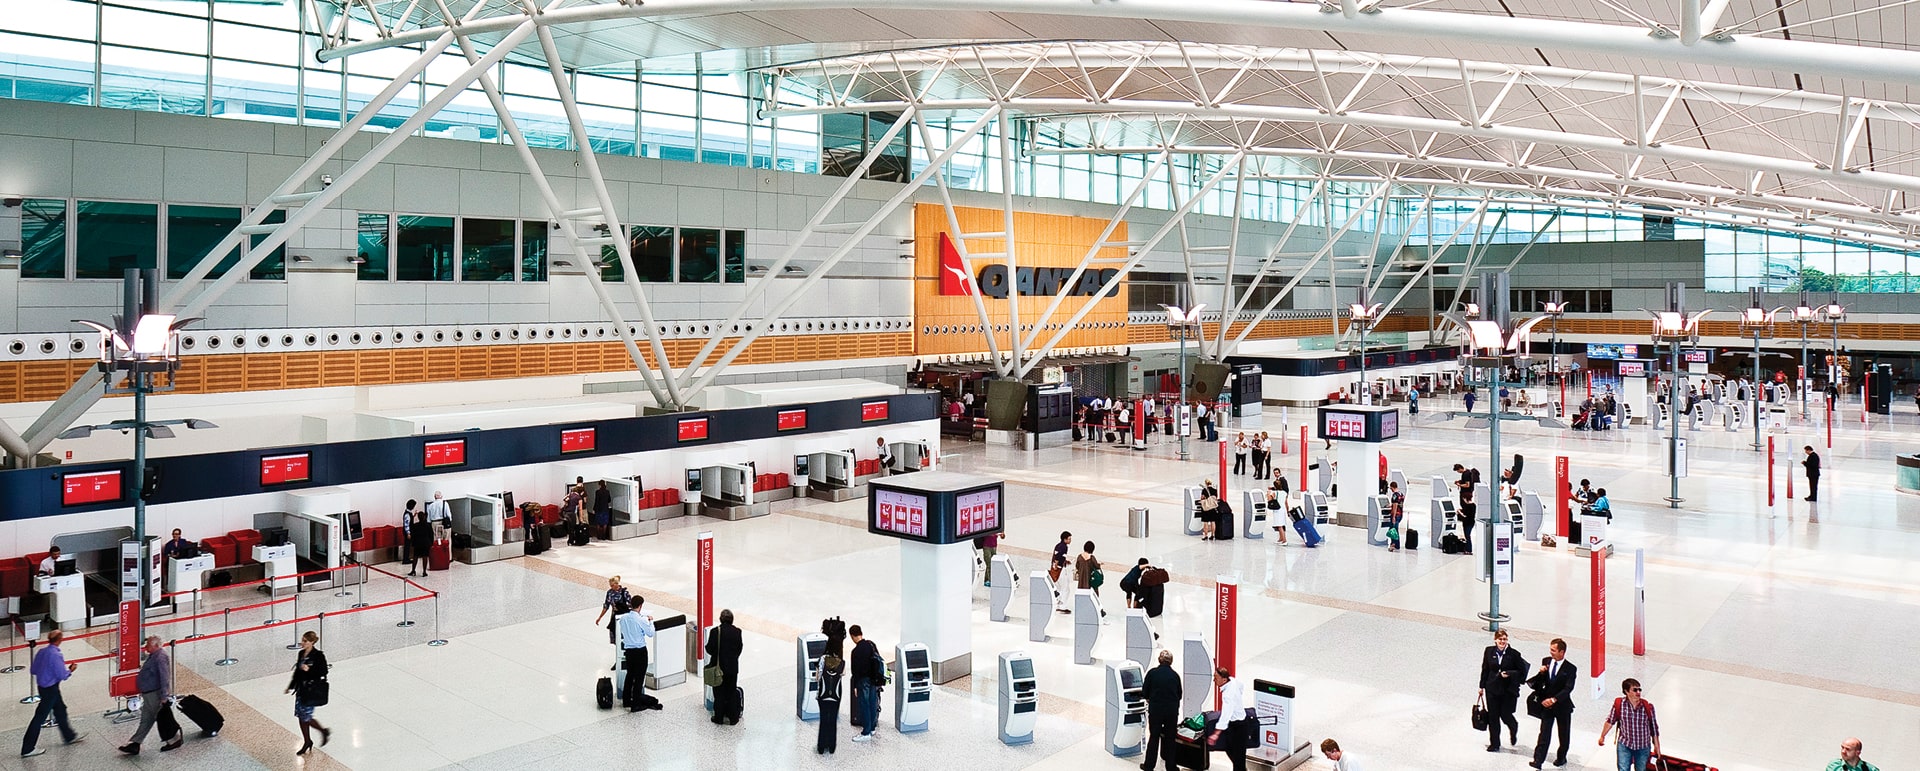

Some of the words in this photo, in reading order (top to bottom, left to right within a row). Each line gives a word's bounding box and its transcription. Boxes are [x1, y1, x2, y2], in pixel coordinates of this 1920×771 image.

[980, 264, 1119, 299] QANTAS
[702, 548, 711, 571] Weigh
[1219, 594, 1229, 621] Weigh
